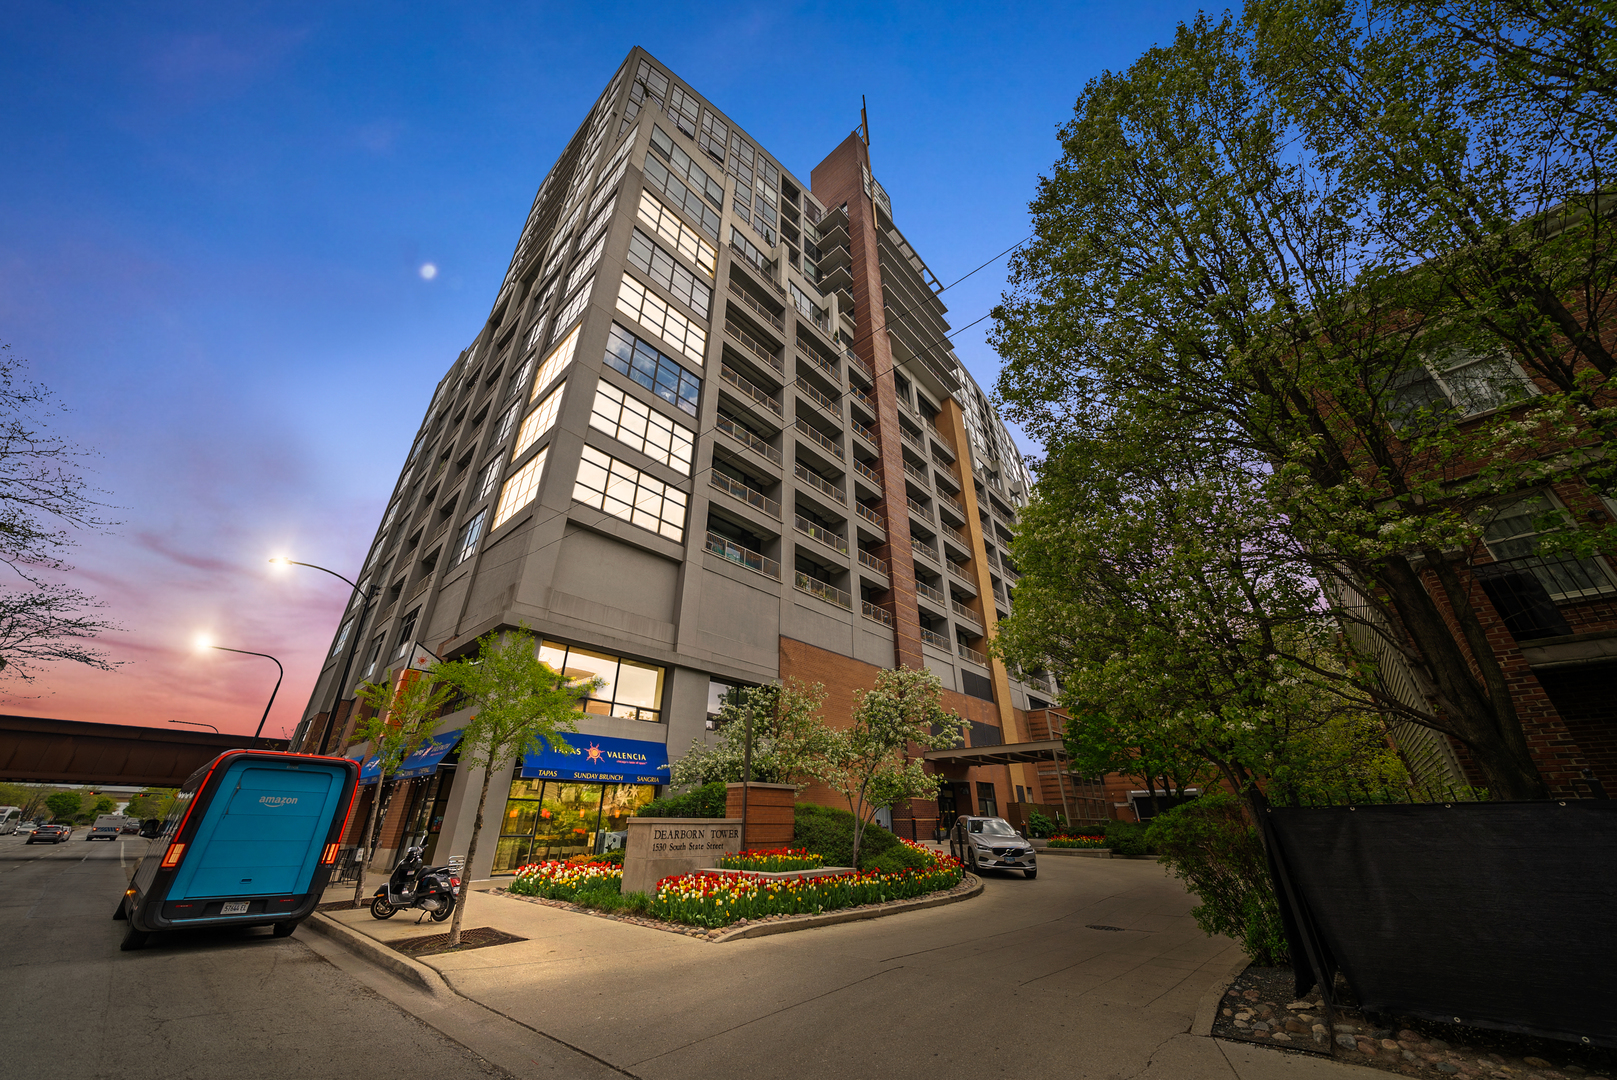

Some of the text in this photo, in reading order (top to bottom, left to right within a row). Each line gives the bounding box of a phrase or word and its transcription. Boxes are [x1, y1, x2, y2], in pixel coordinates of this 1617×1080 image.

[607, 750, 646, 761] VALENCIA
[574, 772, 598, 780] SUNDAY
[259, 796, 298, 805] amazon
[654, 830, 739, 840] DEARBORN TOWER
[652, 841, 724, 852] 1530 South State Street
